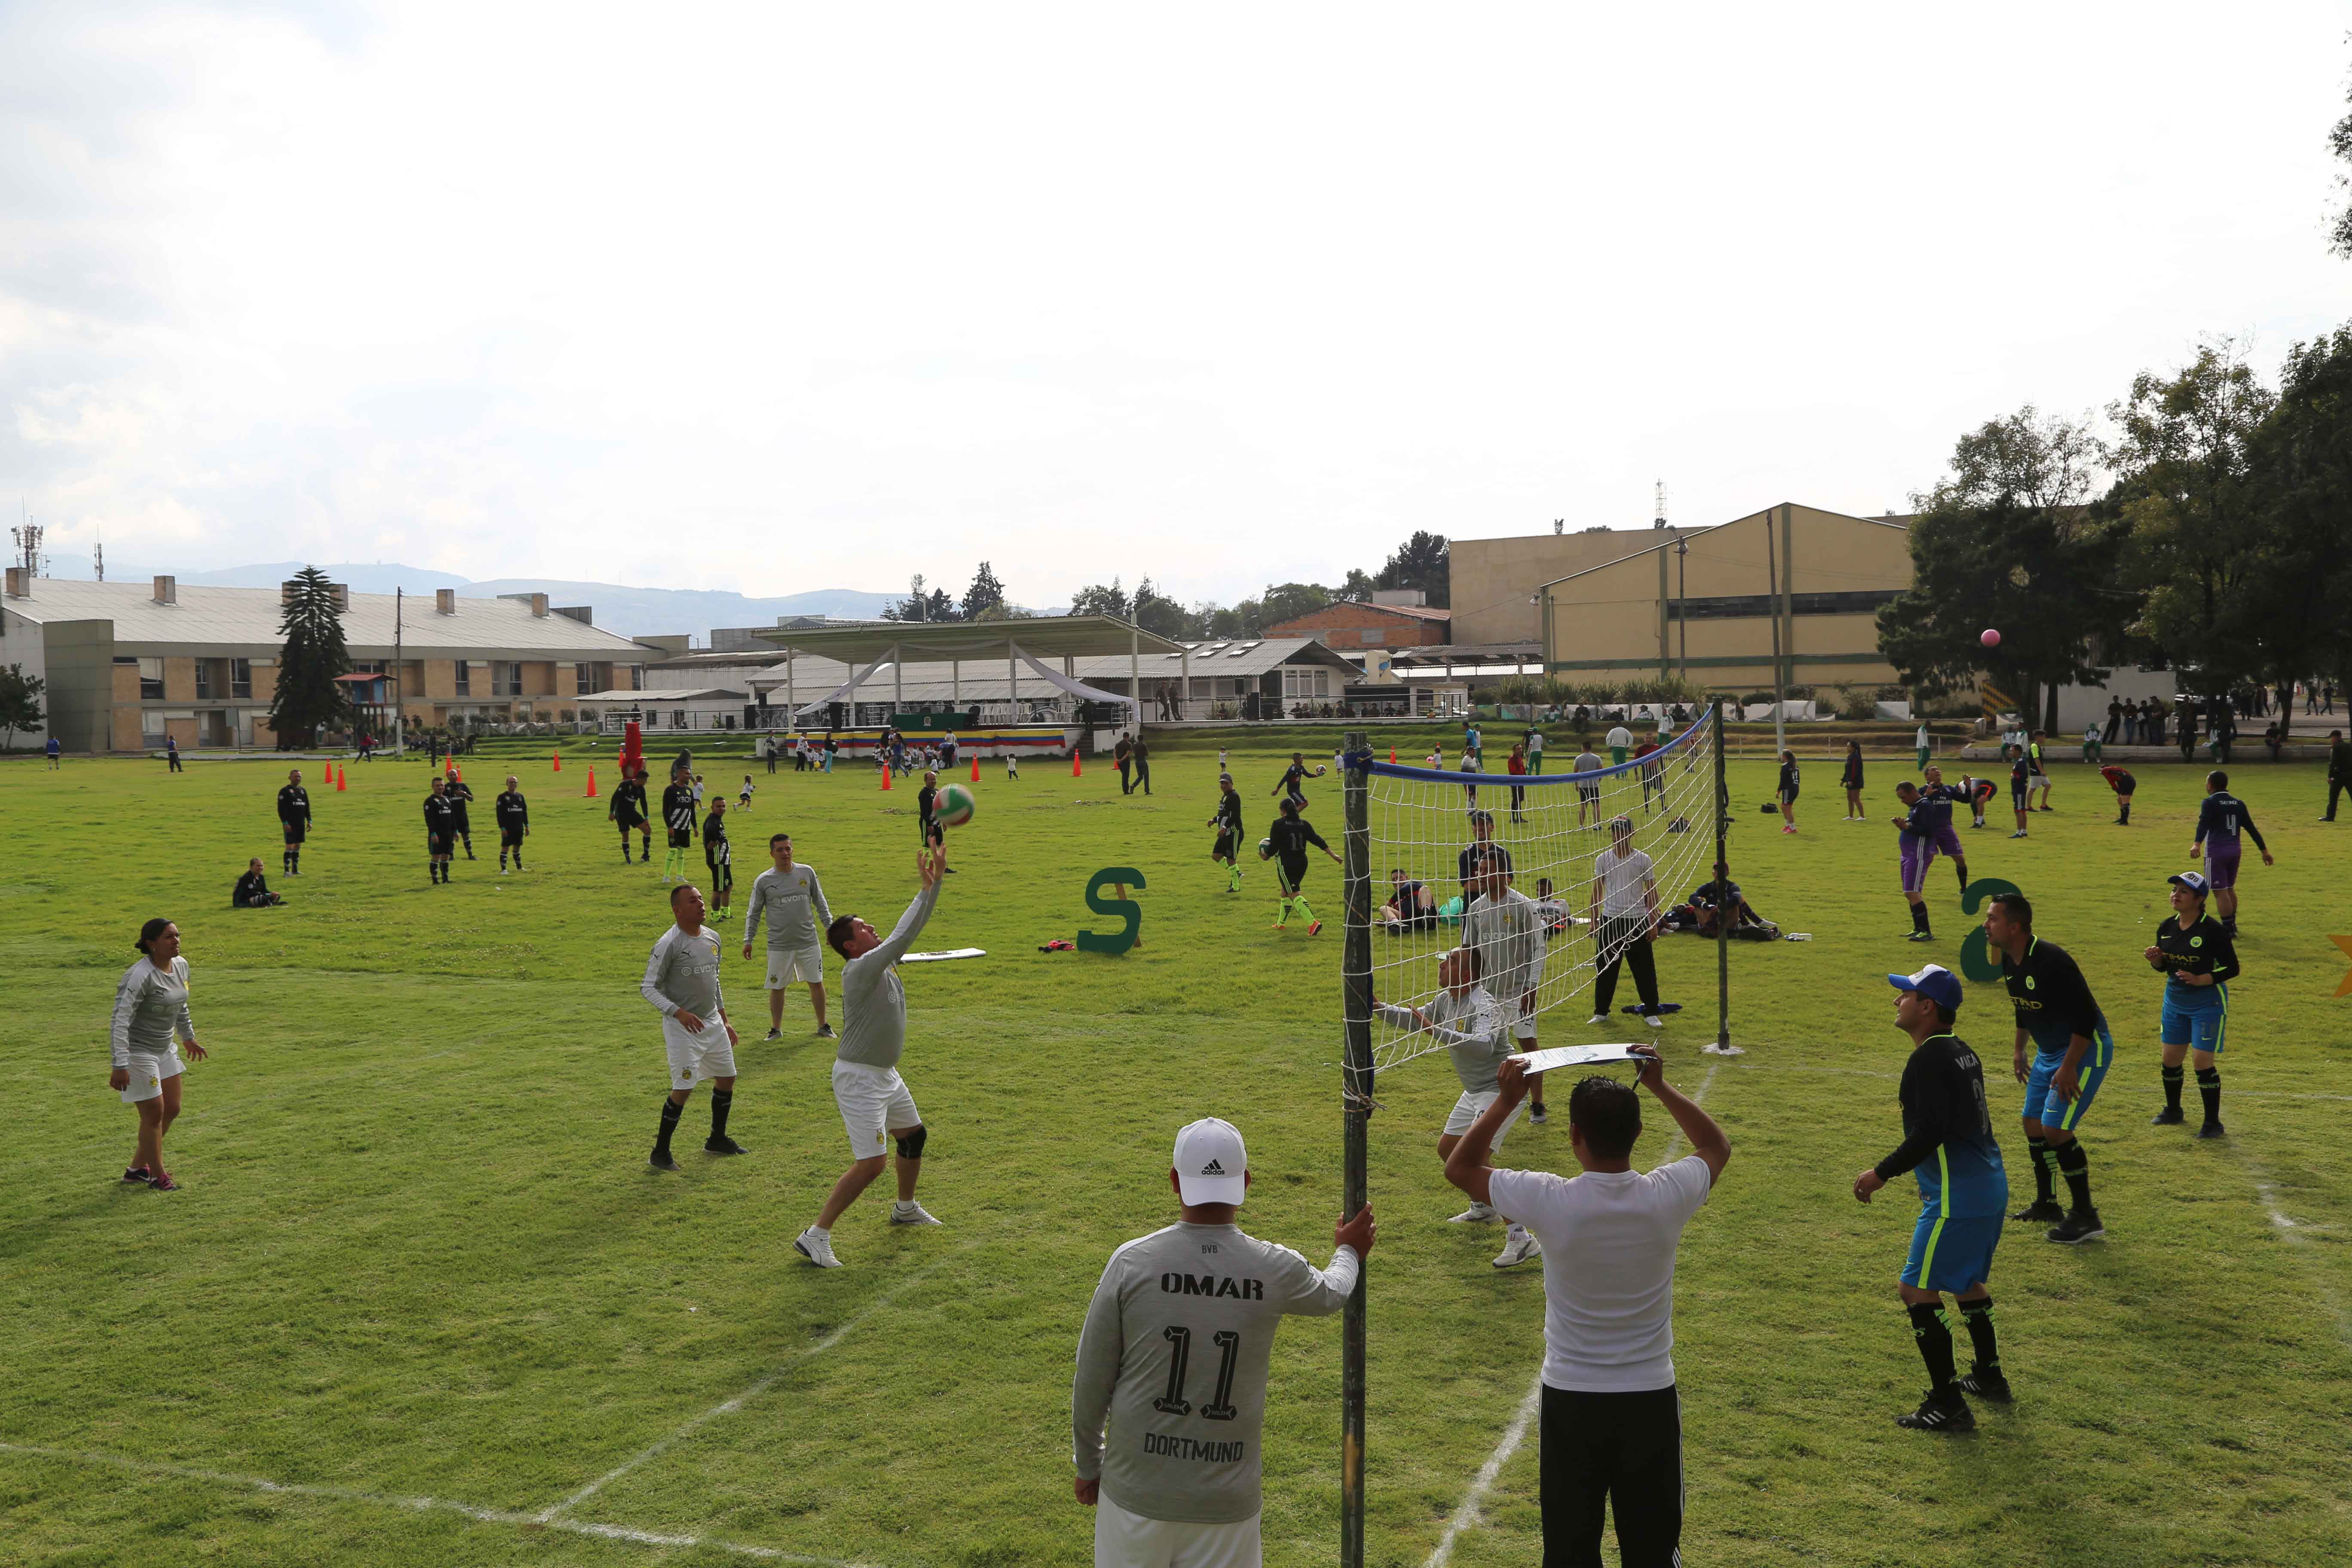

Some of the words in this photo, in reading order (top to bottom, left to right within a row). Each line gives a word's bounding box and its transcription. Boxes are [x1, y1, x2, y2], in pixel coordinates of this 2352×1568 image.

[2226, 815, 2236, 835] 4
[1077, 867, 1146, 955] S
[1955, 1054, 1979, 1070] VACA
[1202, 1245, 1218, 1254] BVB
[1161, 1273, 1264, 1301] OMAR
[1152, 1326, 1237, 1421] 11
[1144, 1433, 1243, 1462] DORTMUND
